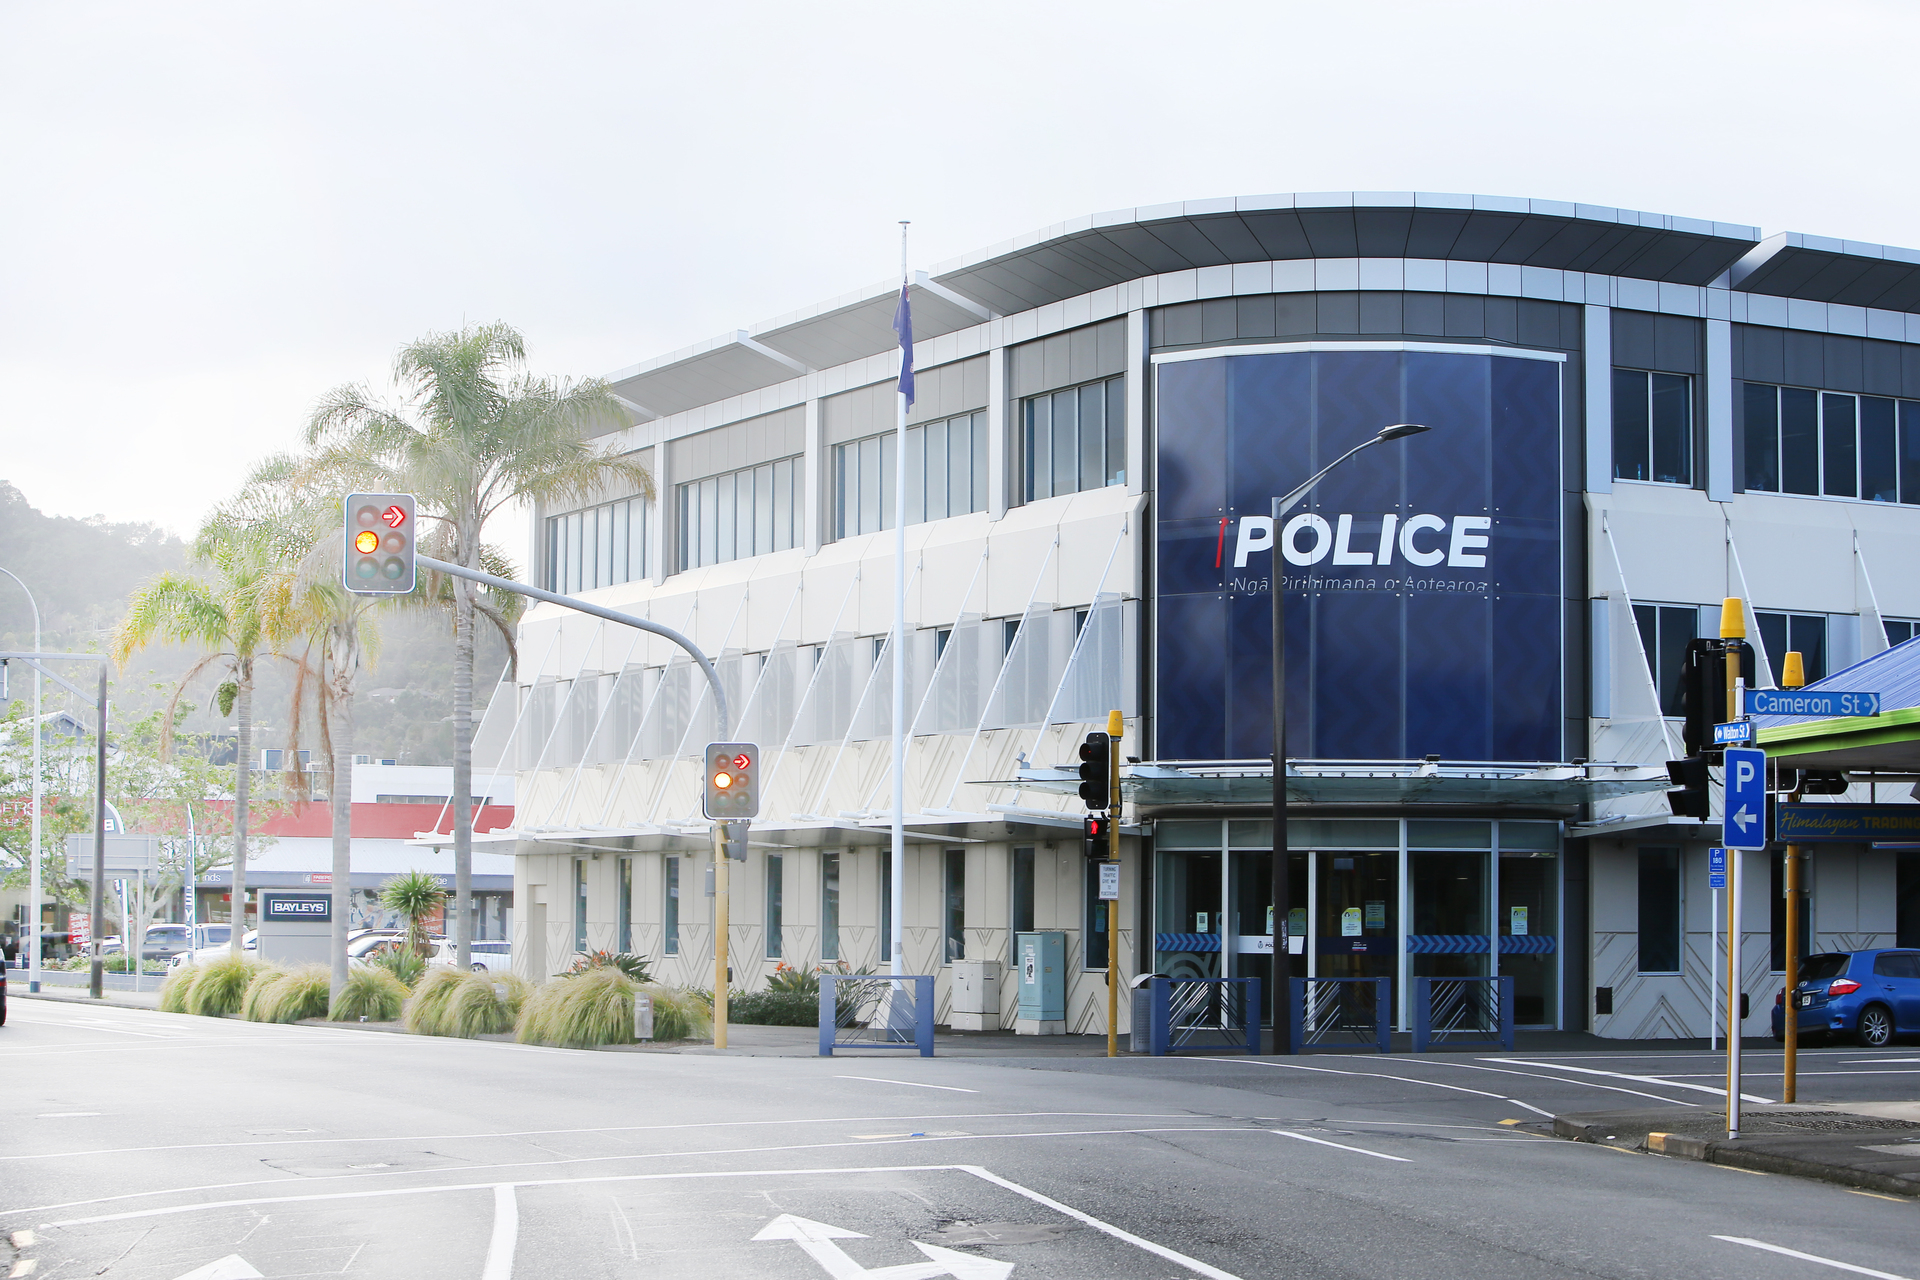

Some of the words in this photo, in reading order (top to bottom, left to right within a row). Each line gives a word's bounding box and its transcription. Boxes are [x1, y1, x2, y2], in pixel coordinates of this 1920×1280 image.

[1234, 513, 1491, 568] POLICE
[1234, 577, 1268, 596] Ngā
[1405, 576, 1486, 592] Aotearoa
[1754, 692, 1831, 713] Cameron
[1840, 694, 1860, 714] St
[1723, 726, 1739, 740] Walton
[1739, 724, 1745, 738] St
[1736, 760, 1755, 793] P
[1780, 812, 1860, 835] Himalayan
[1862, 816, 1920, 830] TRADING
[274, 902, 324, 912] BAYLEYS
